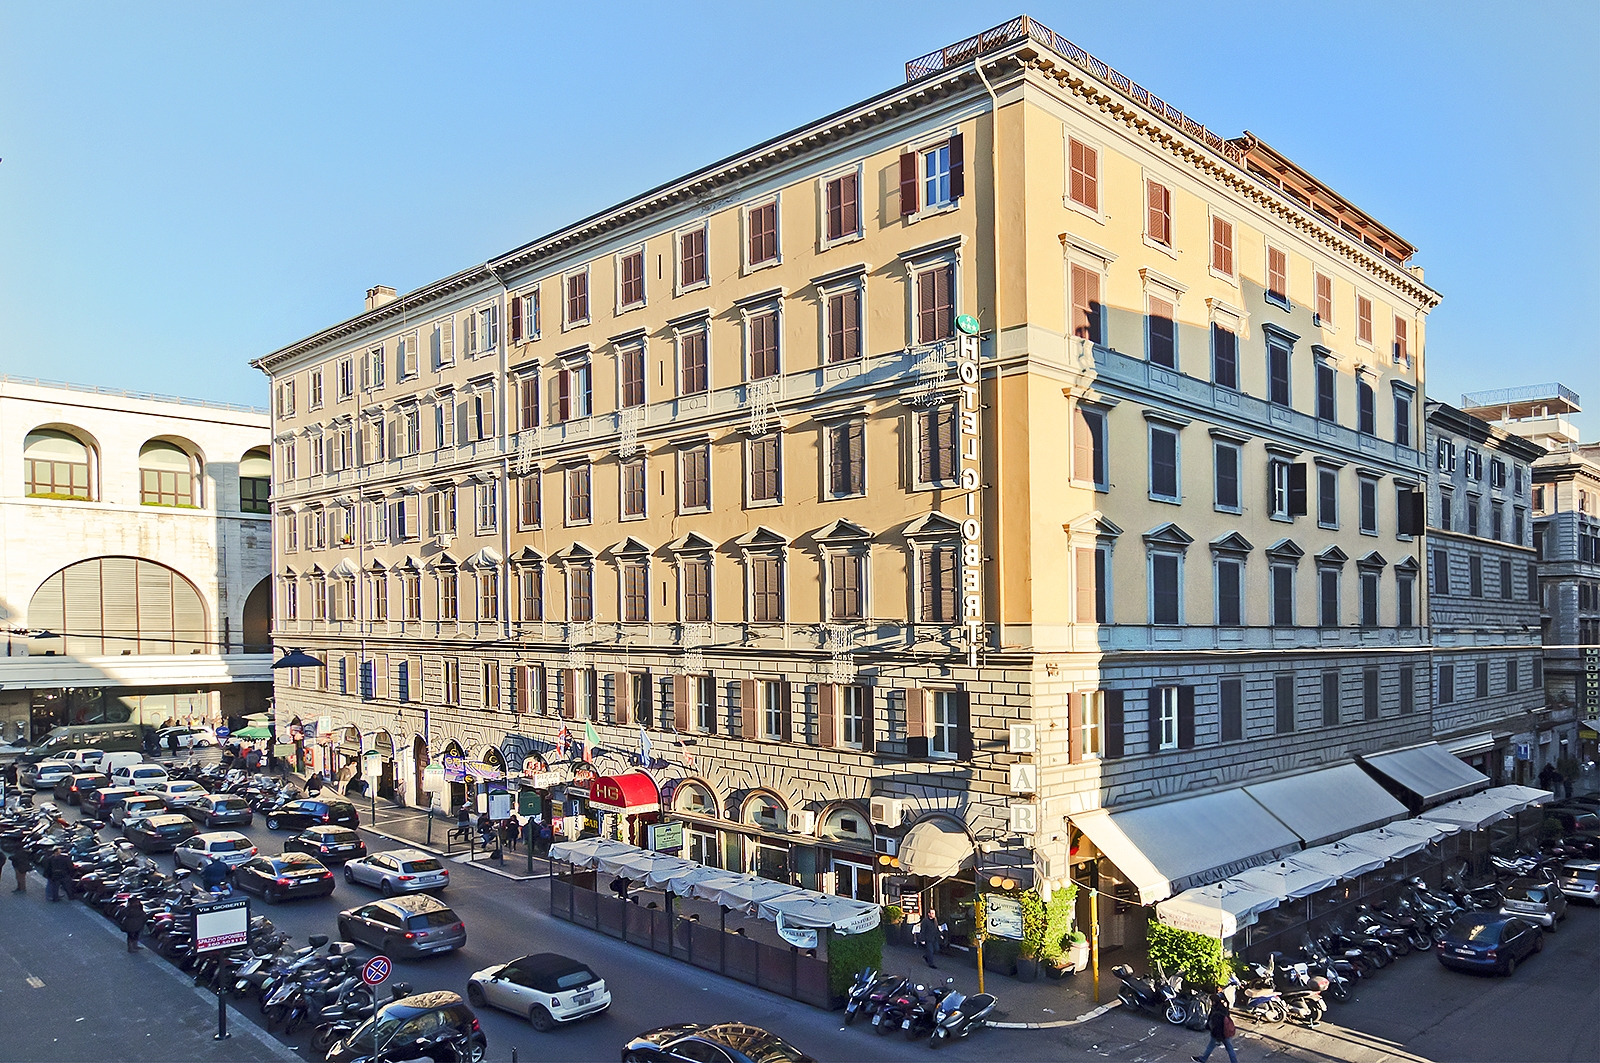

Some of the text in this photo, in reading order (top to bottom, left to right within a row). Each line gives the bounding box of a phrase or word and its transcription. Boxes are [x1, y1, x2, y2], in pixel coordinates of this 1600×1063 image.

[1586, 648, 1599, 720] TRATTORIA
[596, 783, 619, 801] HG
[1013, 726, 1034, 830] BAR
[1188, 854, 1268, 887] LA CAFFETTERIA
[212, 902, 246, 910] GIOBERTI
